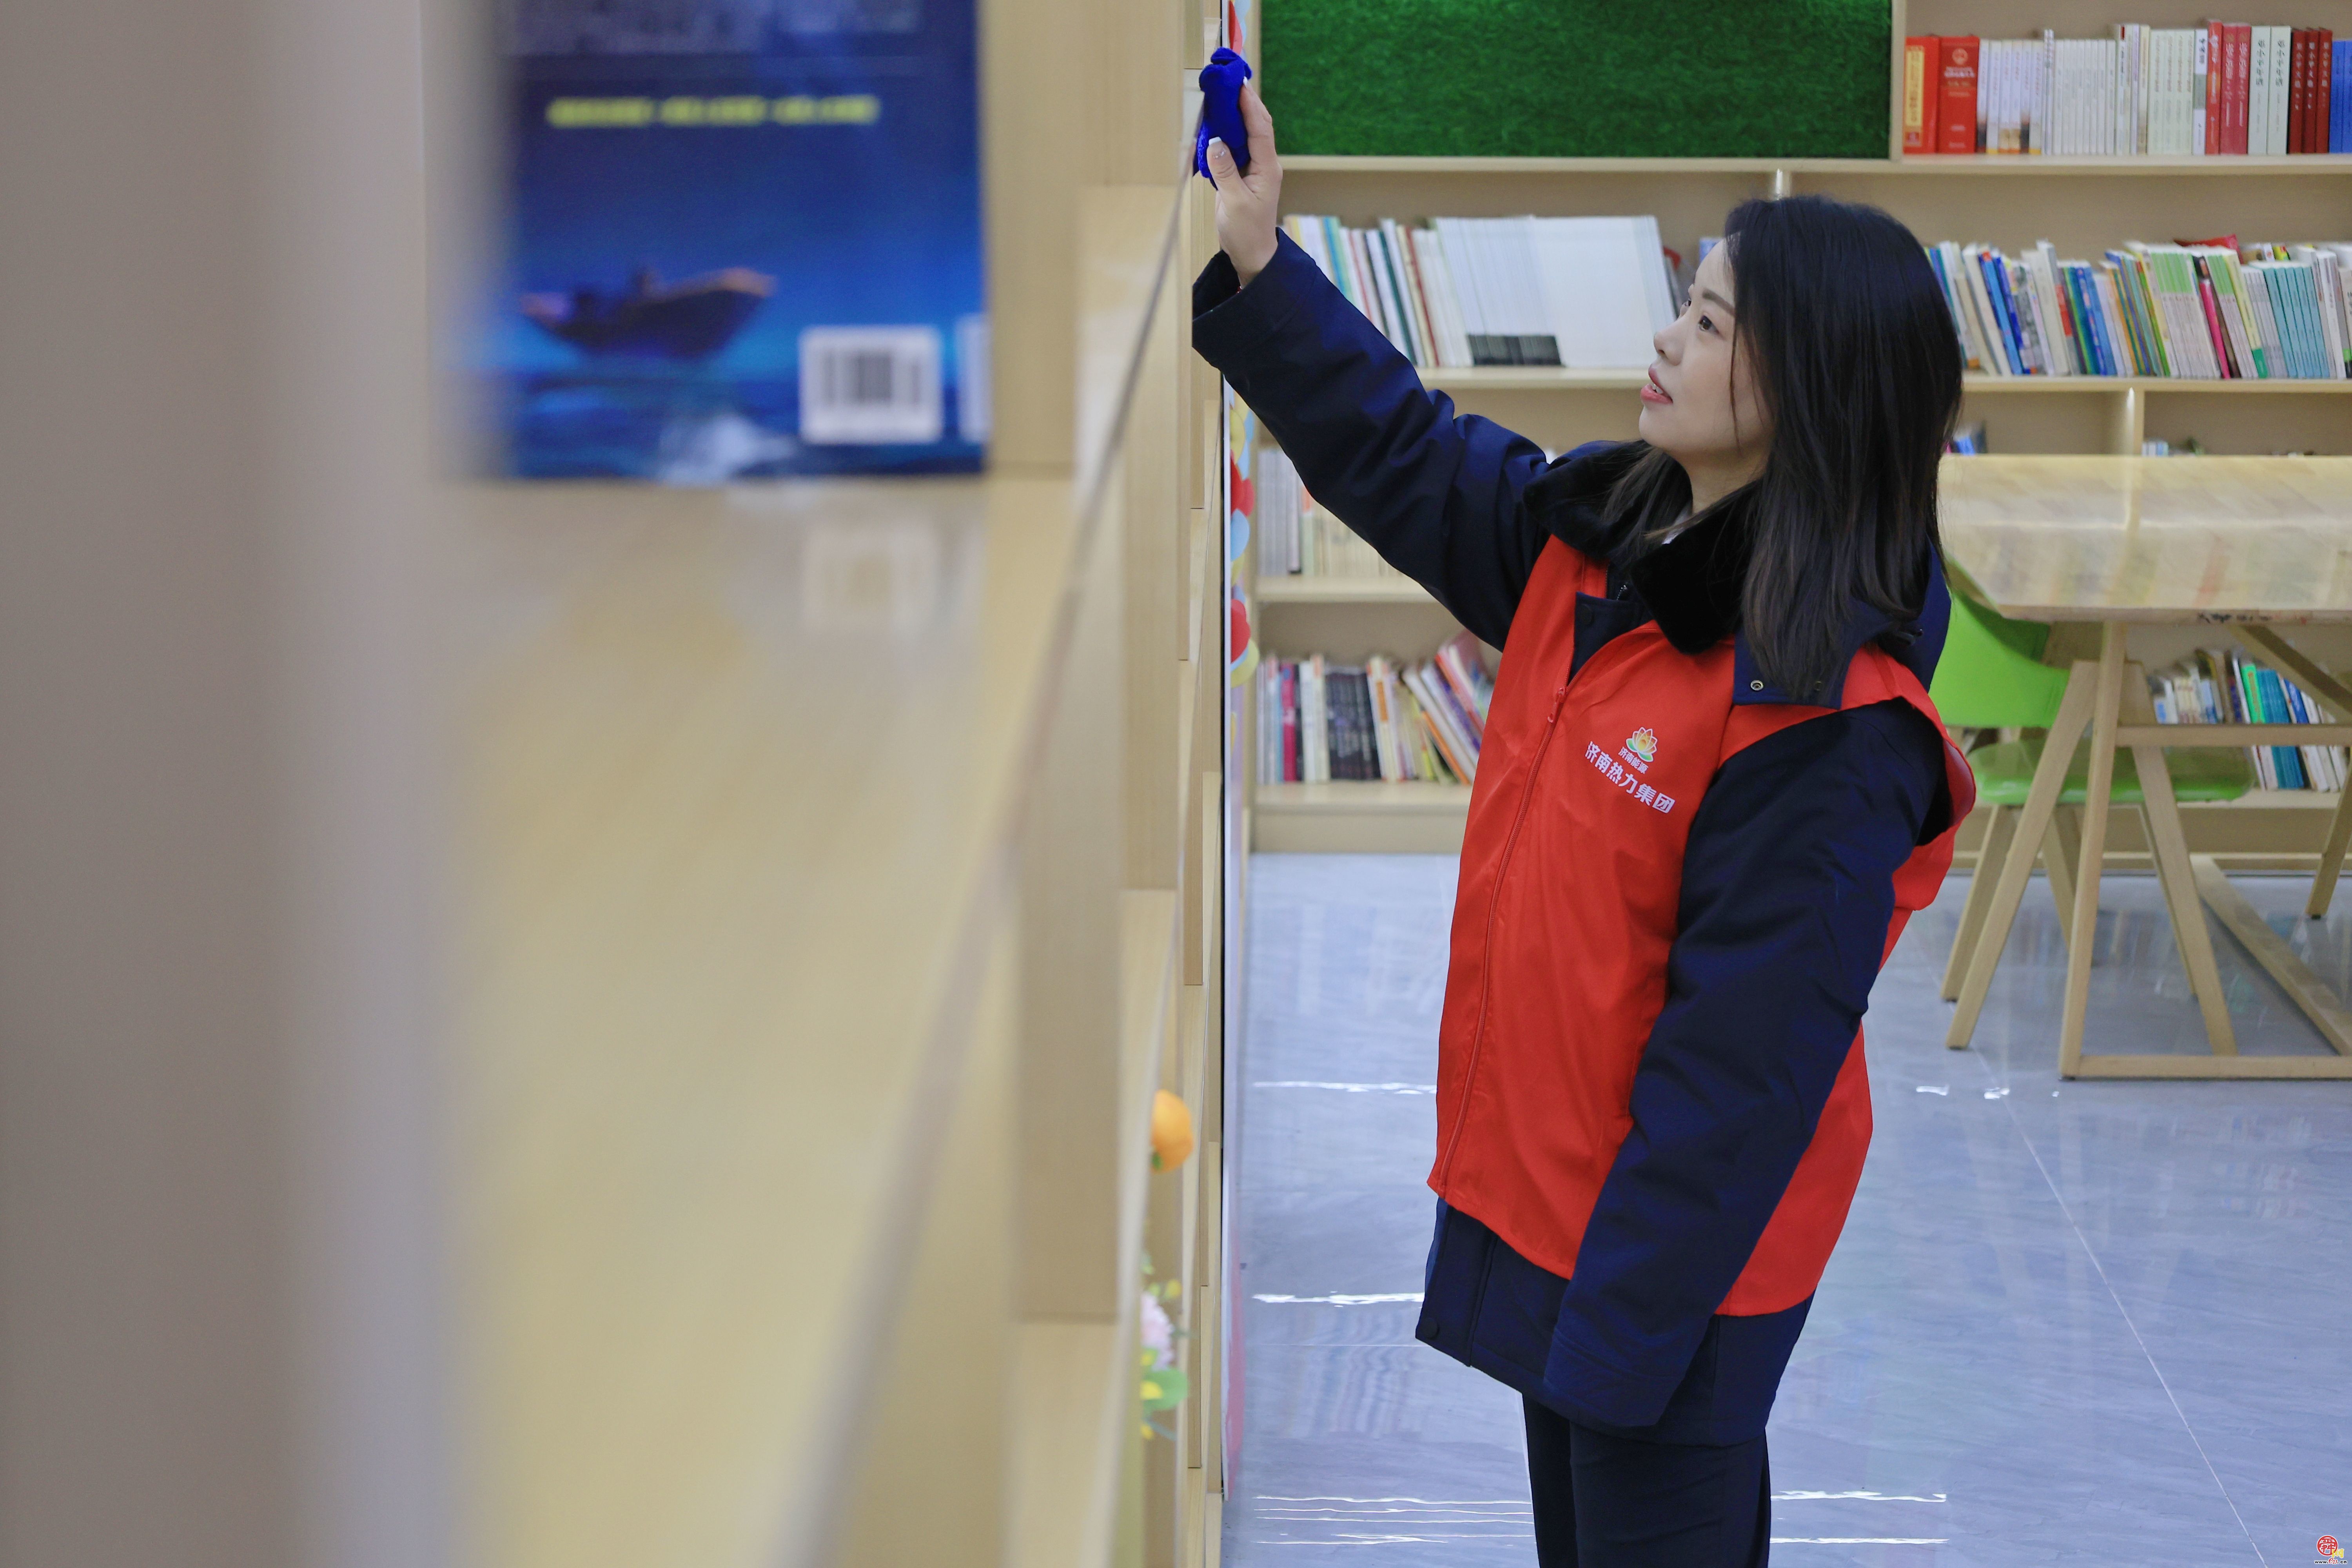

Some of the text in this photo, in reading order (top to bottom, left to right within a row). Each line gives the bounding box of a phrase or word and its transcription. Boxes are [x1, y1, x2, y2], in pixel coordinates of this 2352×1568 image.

[1584, 741, 1675, 813] 济南热力集团
[1618, 746, 1648, 774] 济南能源
